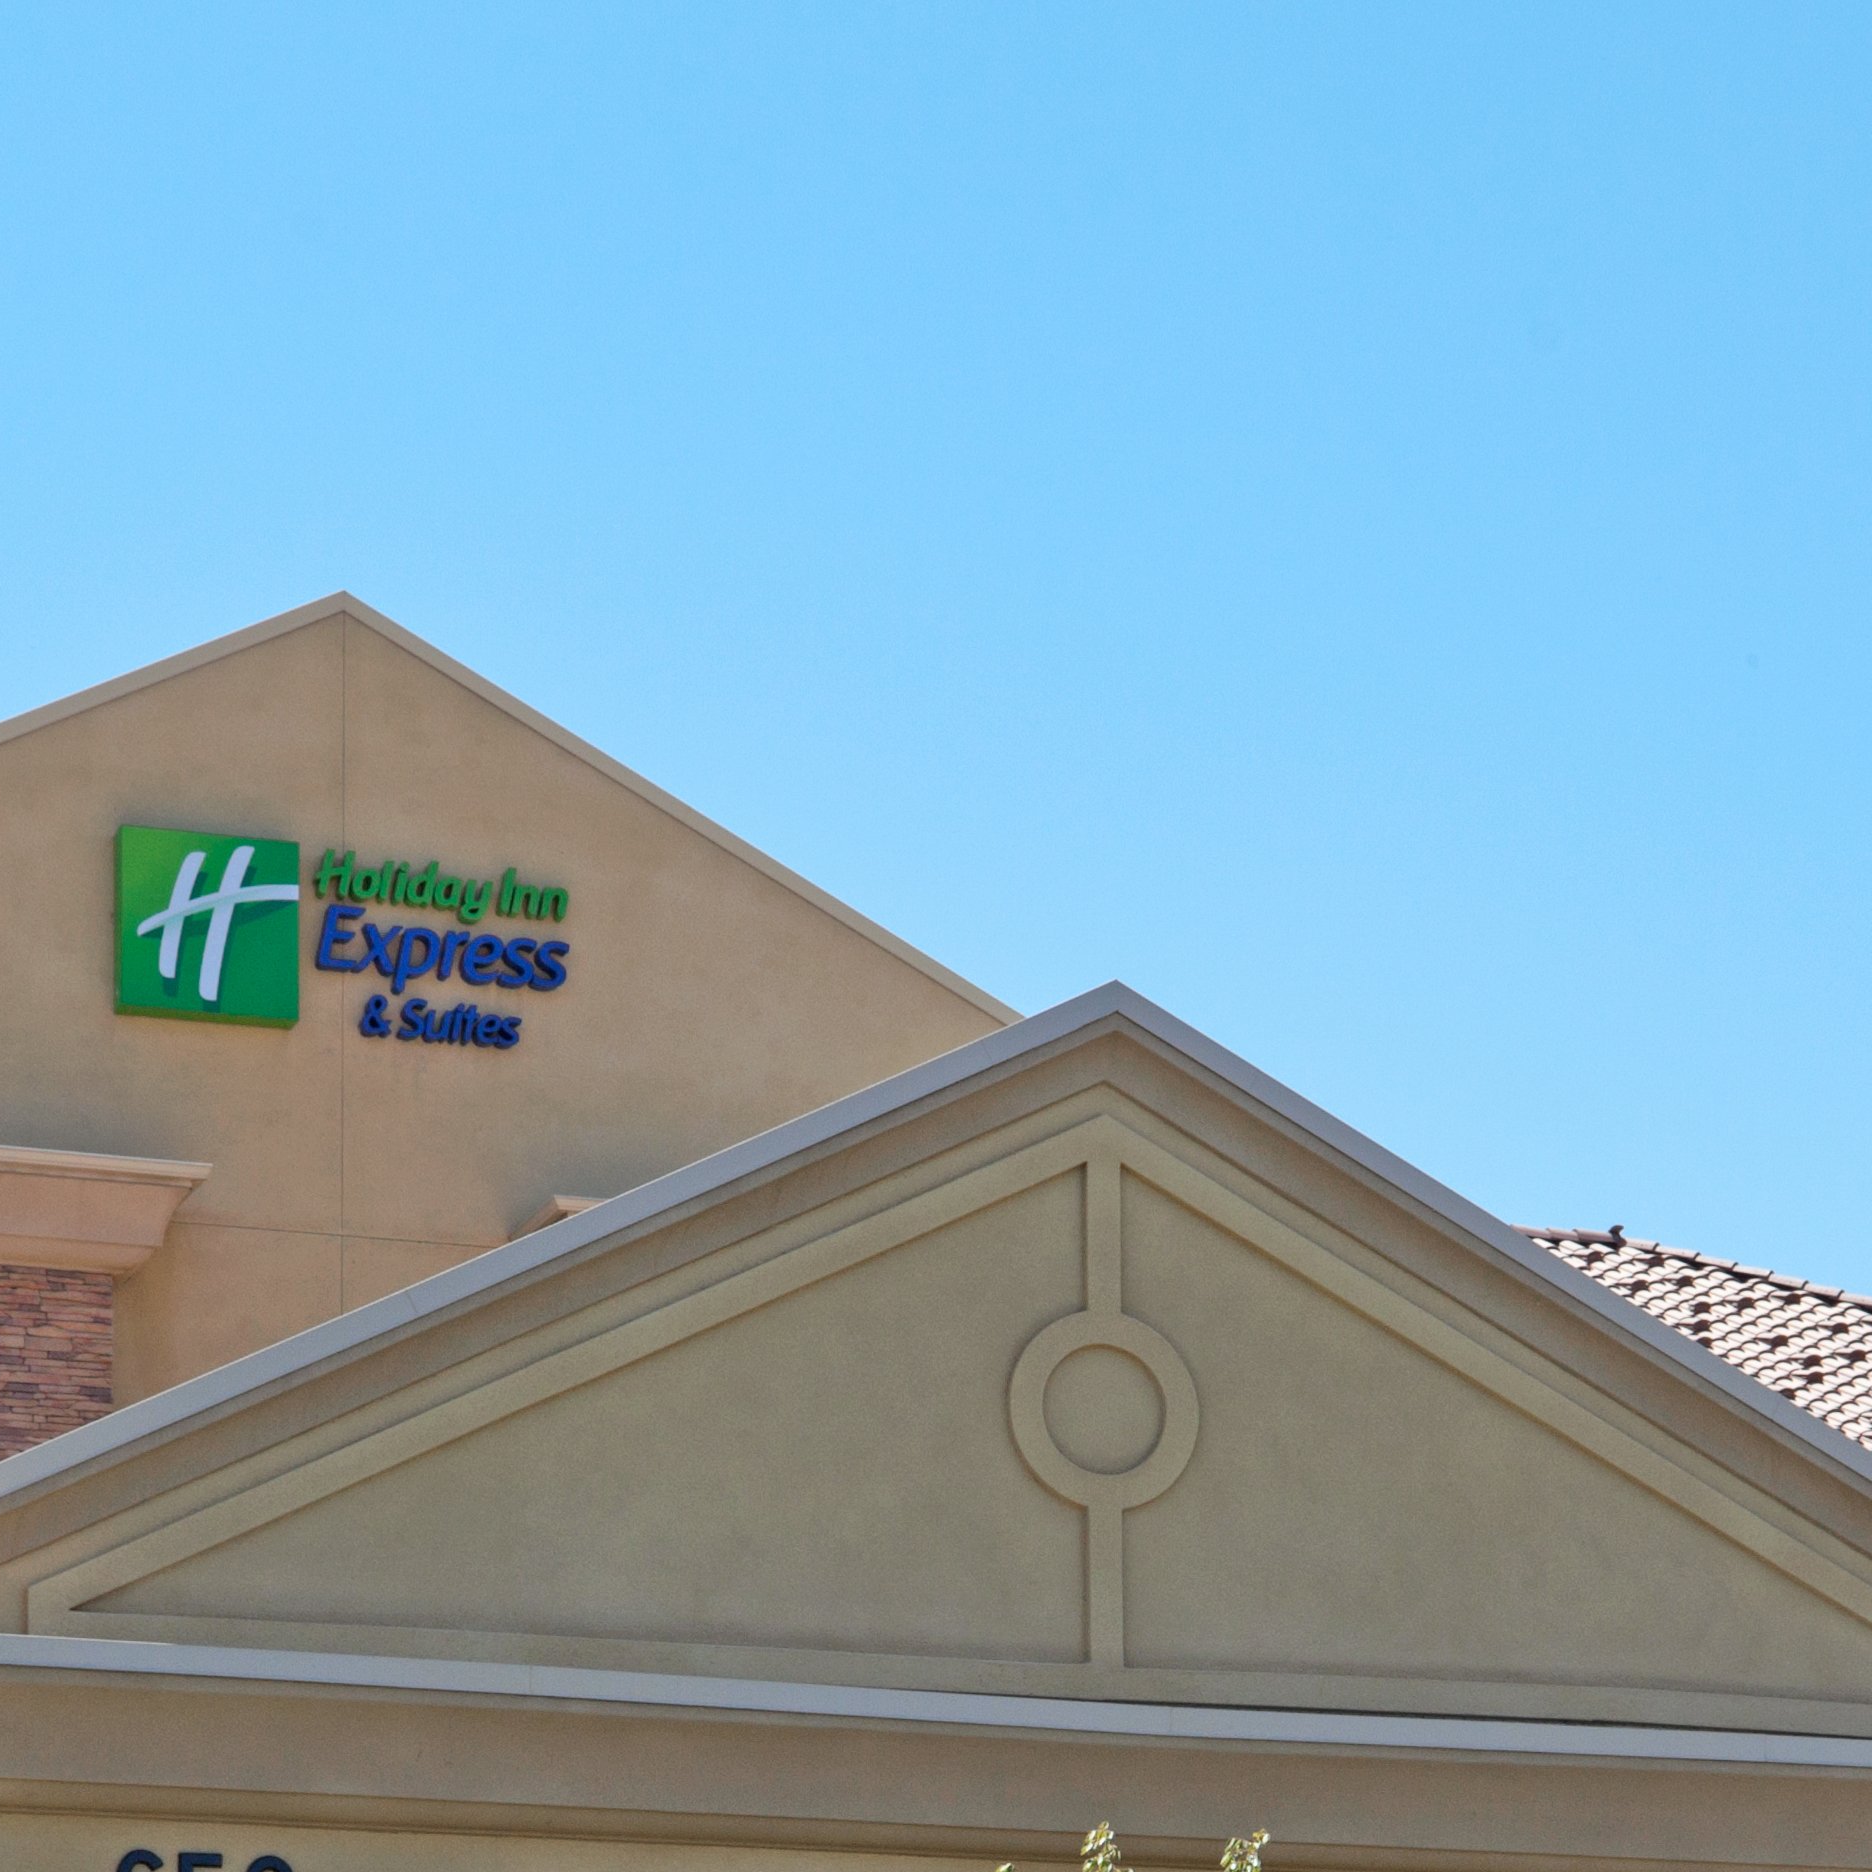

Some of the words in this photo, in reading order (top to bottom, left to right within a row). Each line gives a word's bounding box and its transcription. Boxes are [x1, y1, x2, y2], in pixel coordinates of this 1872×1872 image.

[314, 849, 494, 924] Holiday
[496, 867, 569, 922] Inn
[316, 904, 570, 994] Express
[359, 994, 392, 1038] &
[397, 998, 522, 1048] Suites
